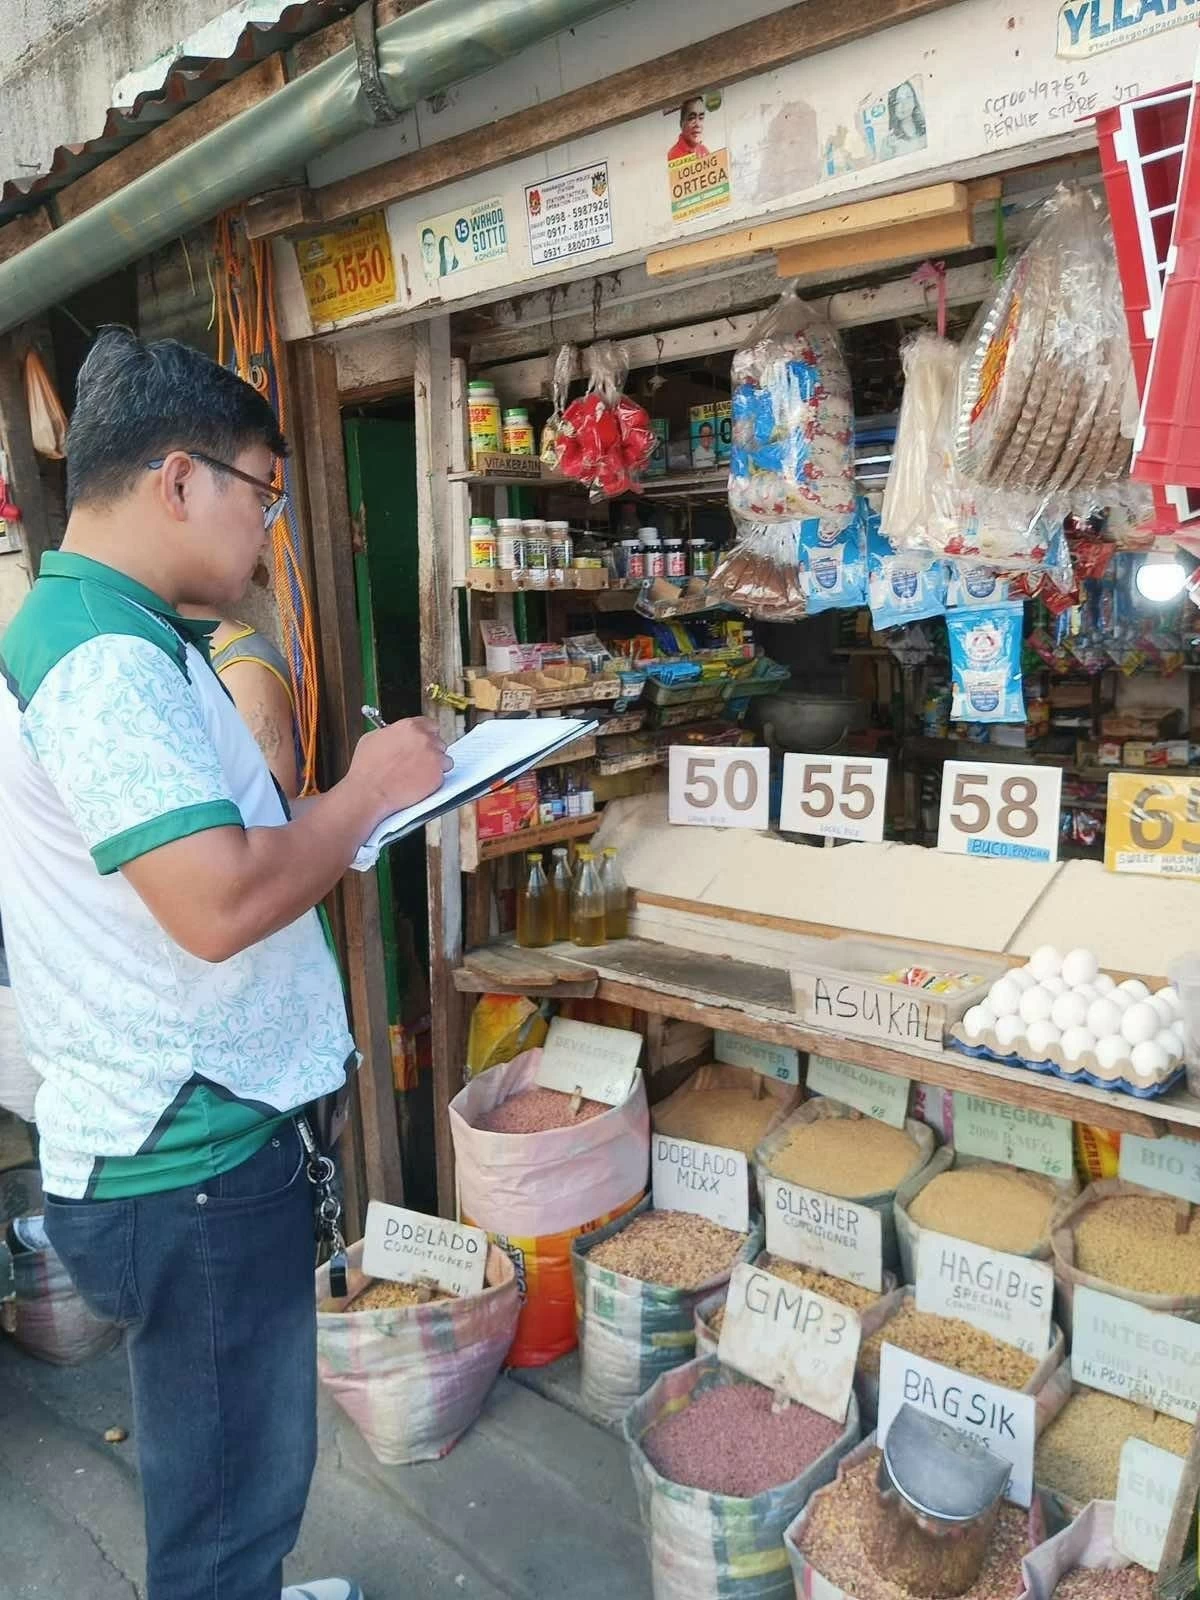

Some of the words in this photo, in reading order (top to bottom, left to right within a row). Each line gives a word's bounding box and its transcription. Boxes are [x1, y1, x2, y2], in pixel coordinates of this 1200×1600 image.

[984, 112, 1039, 143] BERNIE
[1048, 92, 1099, 120] STORE
[673, 168, 728, 199] ORTEGA
[679, 156, 718, 180] LOLONG
[472, 224, 506, 252] SOTTO
[684, 757, 758, 811] 50
[800, 764, 875, 820] 55
[950, 773, 1038, 837] 58
[972, 840, 1008, 856] BUCO
[815, 977, 943, 1042] ASUKAL
[967, 1096, 1056, 1130] INTEGRA
[658, 1141, 736, 1176] DOBLADO
[1141, 1147, 1185, 1175] BIO
[677, 1167, 720, 1194] MIXX
[776, 1187, 859, 1236] SLASHER
[385, 1219, 478, 1254] DOBLADO
[384, 1239, 472, 1271] CONDITIONER
[939, 1249, 1045, 1308] HAGIBIS
[904, 1368, 1016, 1439] BAGSIK
